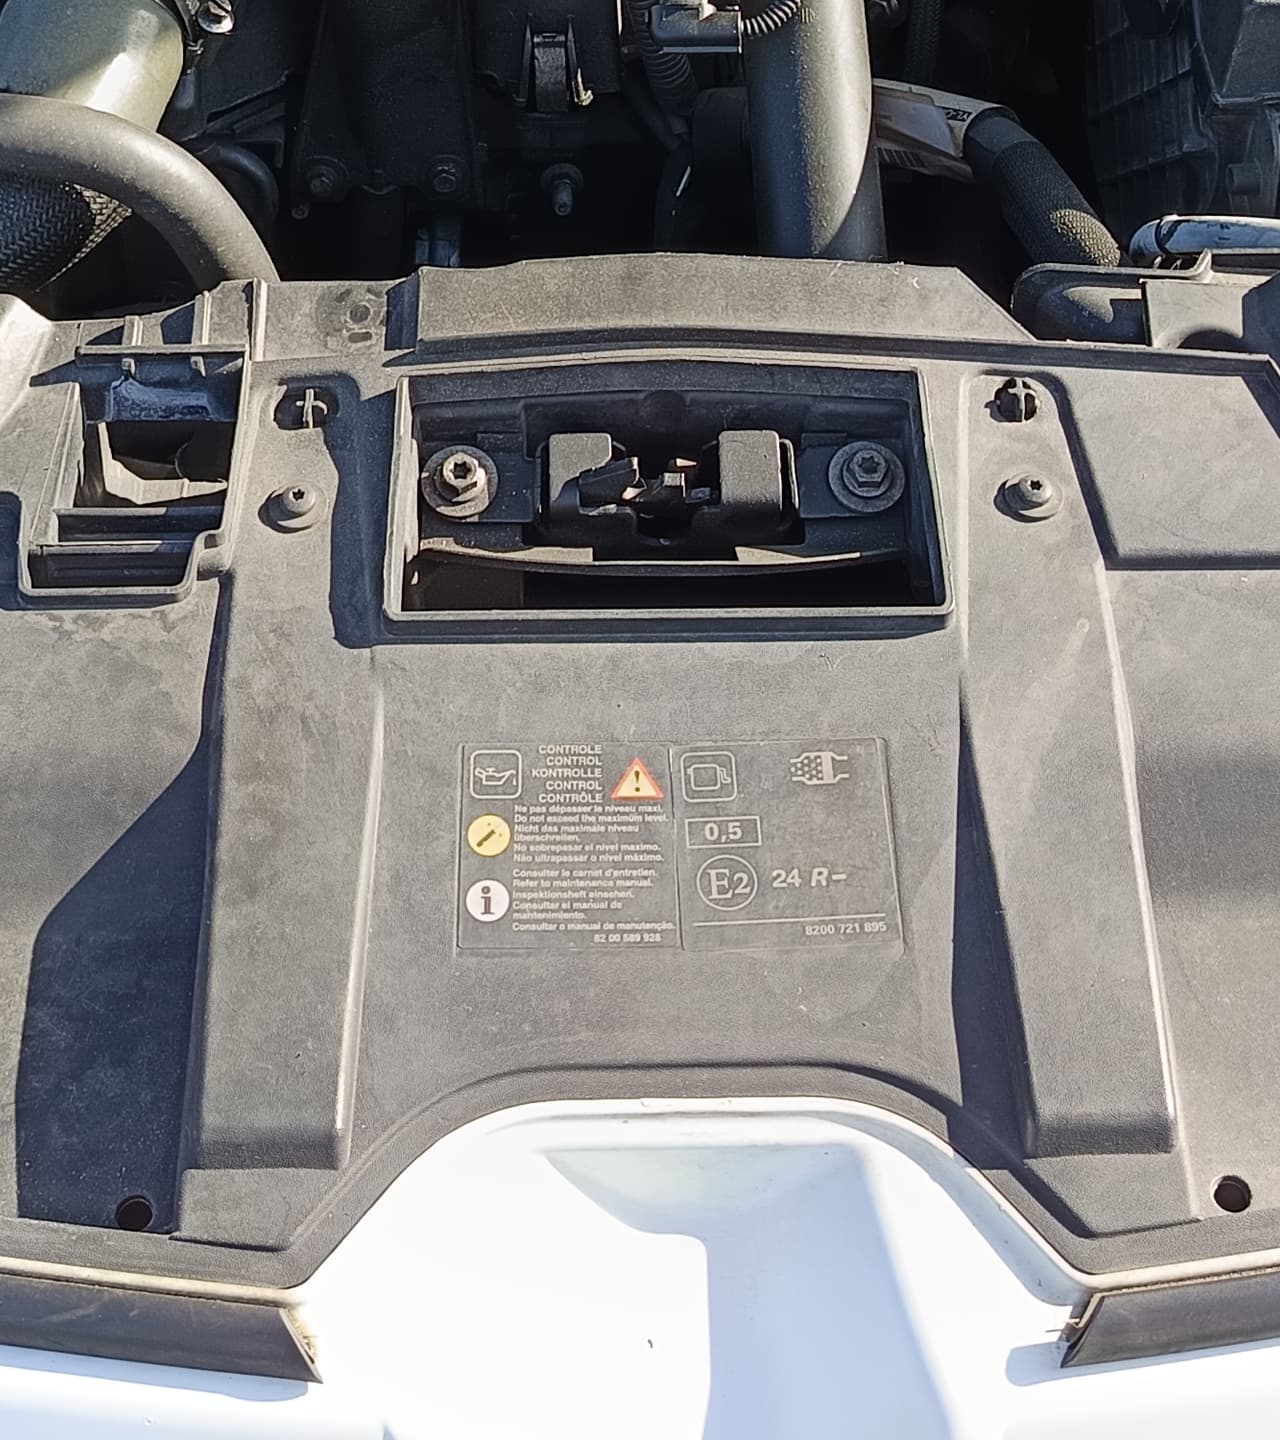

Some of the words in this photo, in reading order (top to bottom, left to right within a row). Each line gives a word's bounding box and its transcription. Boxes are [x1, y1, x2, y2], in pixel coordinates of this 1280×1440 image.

[539, 745, 602, 754] CONTROLE
[546, 757, 602, 765] CONTROL
[532, 768, 602, 777] KONTROLLE
[546, 781, 603, 790] CONTROL
[539, 791, 603, 802] CONTRÔLE
[515, 805, 527, 813] Ne
[529, 806, 546, 814] pas
[594, 805, 603, 813] le
[514, 815, 526, 823] Do
[529, 815, 545, 823] not
[581, 815, 596, 823] the
[704, 822, 742, 842] 0,5
[514, 843, 527, 852] No
[585, 843, 593, 852] el
[595, 843, 618, 852] nivel
[513, 869, 558, 877] Consulter
[561, 869, 570, 877] le
[772, 869, 802, 888] 24
[513, 879, 538, 888] Refer
[541, 879, 551, 888] to
[706, 868, 751, 899] E2
[512, 901, 559, 910] Consultar
[561, 901, 570, 910] el
[611, 901, 622, 910] de
[512, 922, 557, 931] Consultar
[567, 922, 601, 931] manual
[603, 922, 614, 931] de
[840, 924, 860, 933] 721
[609, 934, 620, 943] 00
